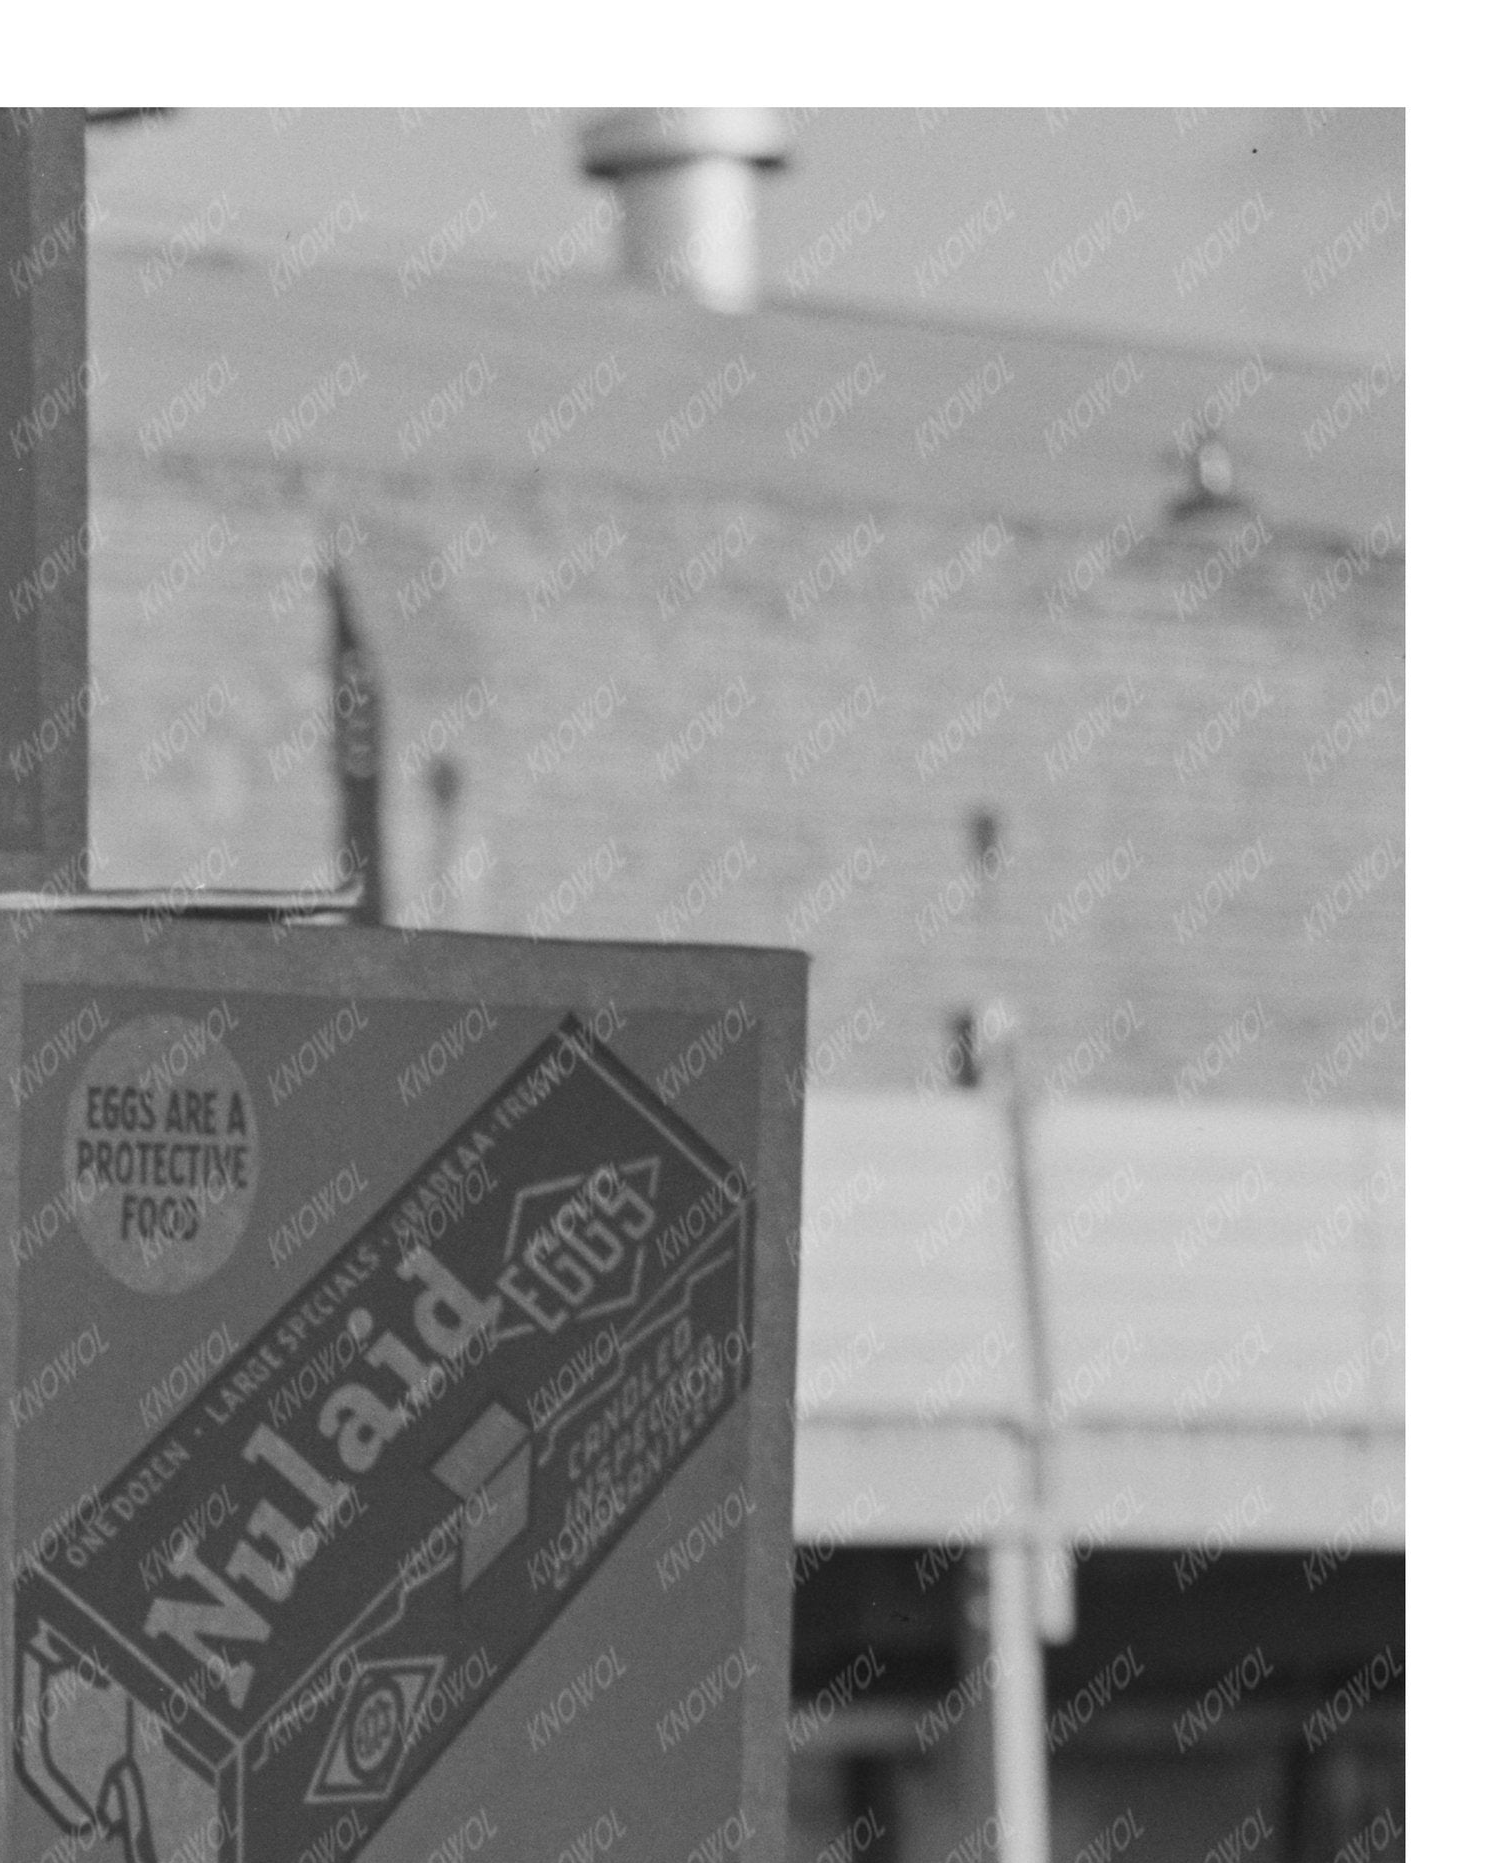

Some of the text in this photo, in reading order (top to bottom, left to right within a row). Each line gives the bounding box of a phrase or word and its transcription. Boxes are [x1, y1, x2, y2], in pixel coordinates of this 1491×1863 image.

[86, 1085, 248, 1136] EGGS ARE A
[77, 1138, 248, 1189] PROTECTIVE
[120, 1196, 201, 1242] FOOD
[499, 1167, 654, 1331] EGGS
[144, 1243, 500, 1708] Nulaid
